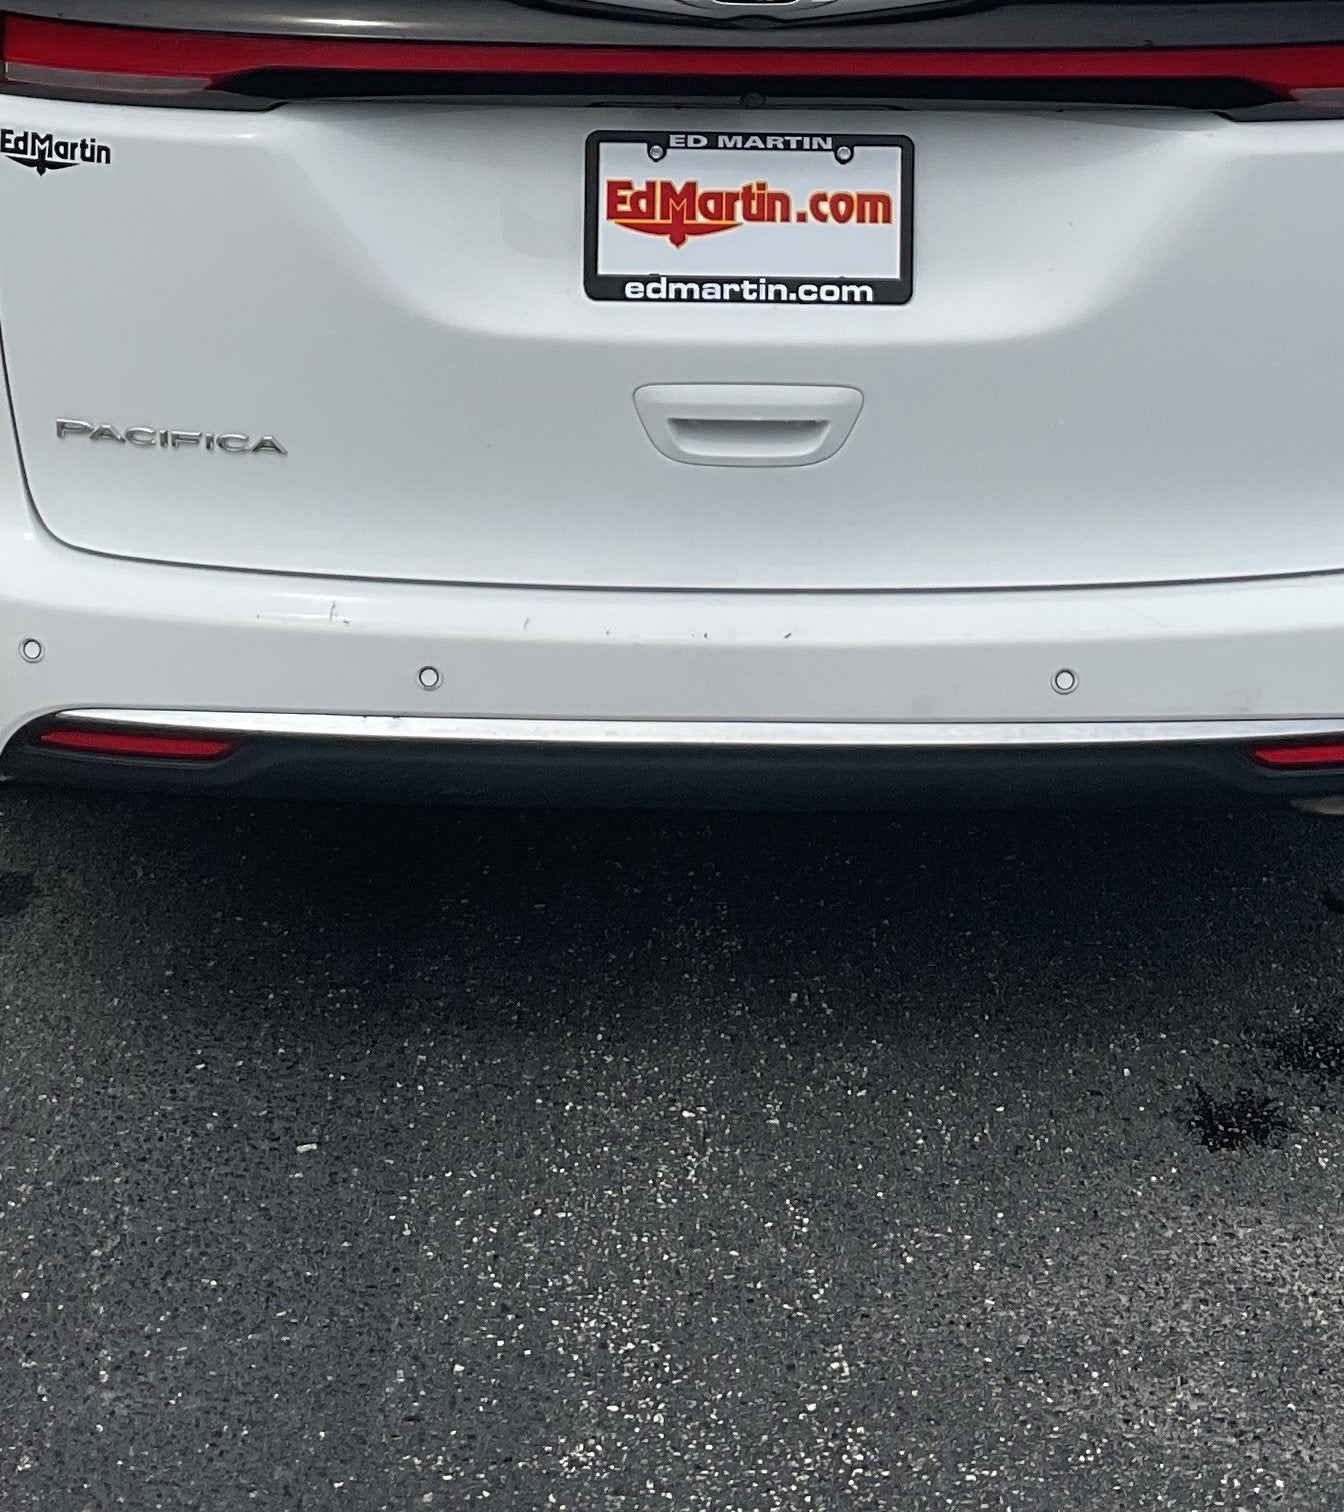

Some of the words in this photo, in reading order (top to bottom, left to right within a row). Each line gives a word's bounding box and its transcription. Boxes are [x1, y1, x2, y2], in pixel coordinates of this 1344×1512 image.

[668, 134, 710, 148] ED
[717, 135, 833, 150] MARTIN
[623, 277, 874, 303] edmartin.com
[55, 417, 289, 455] PACIFICA
